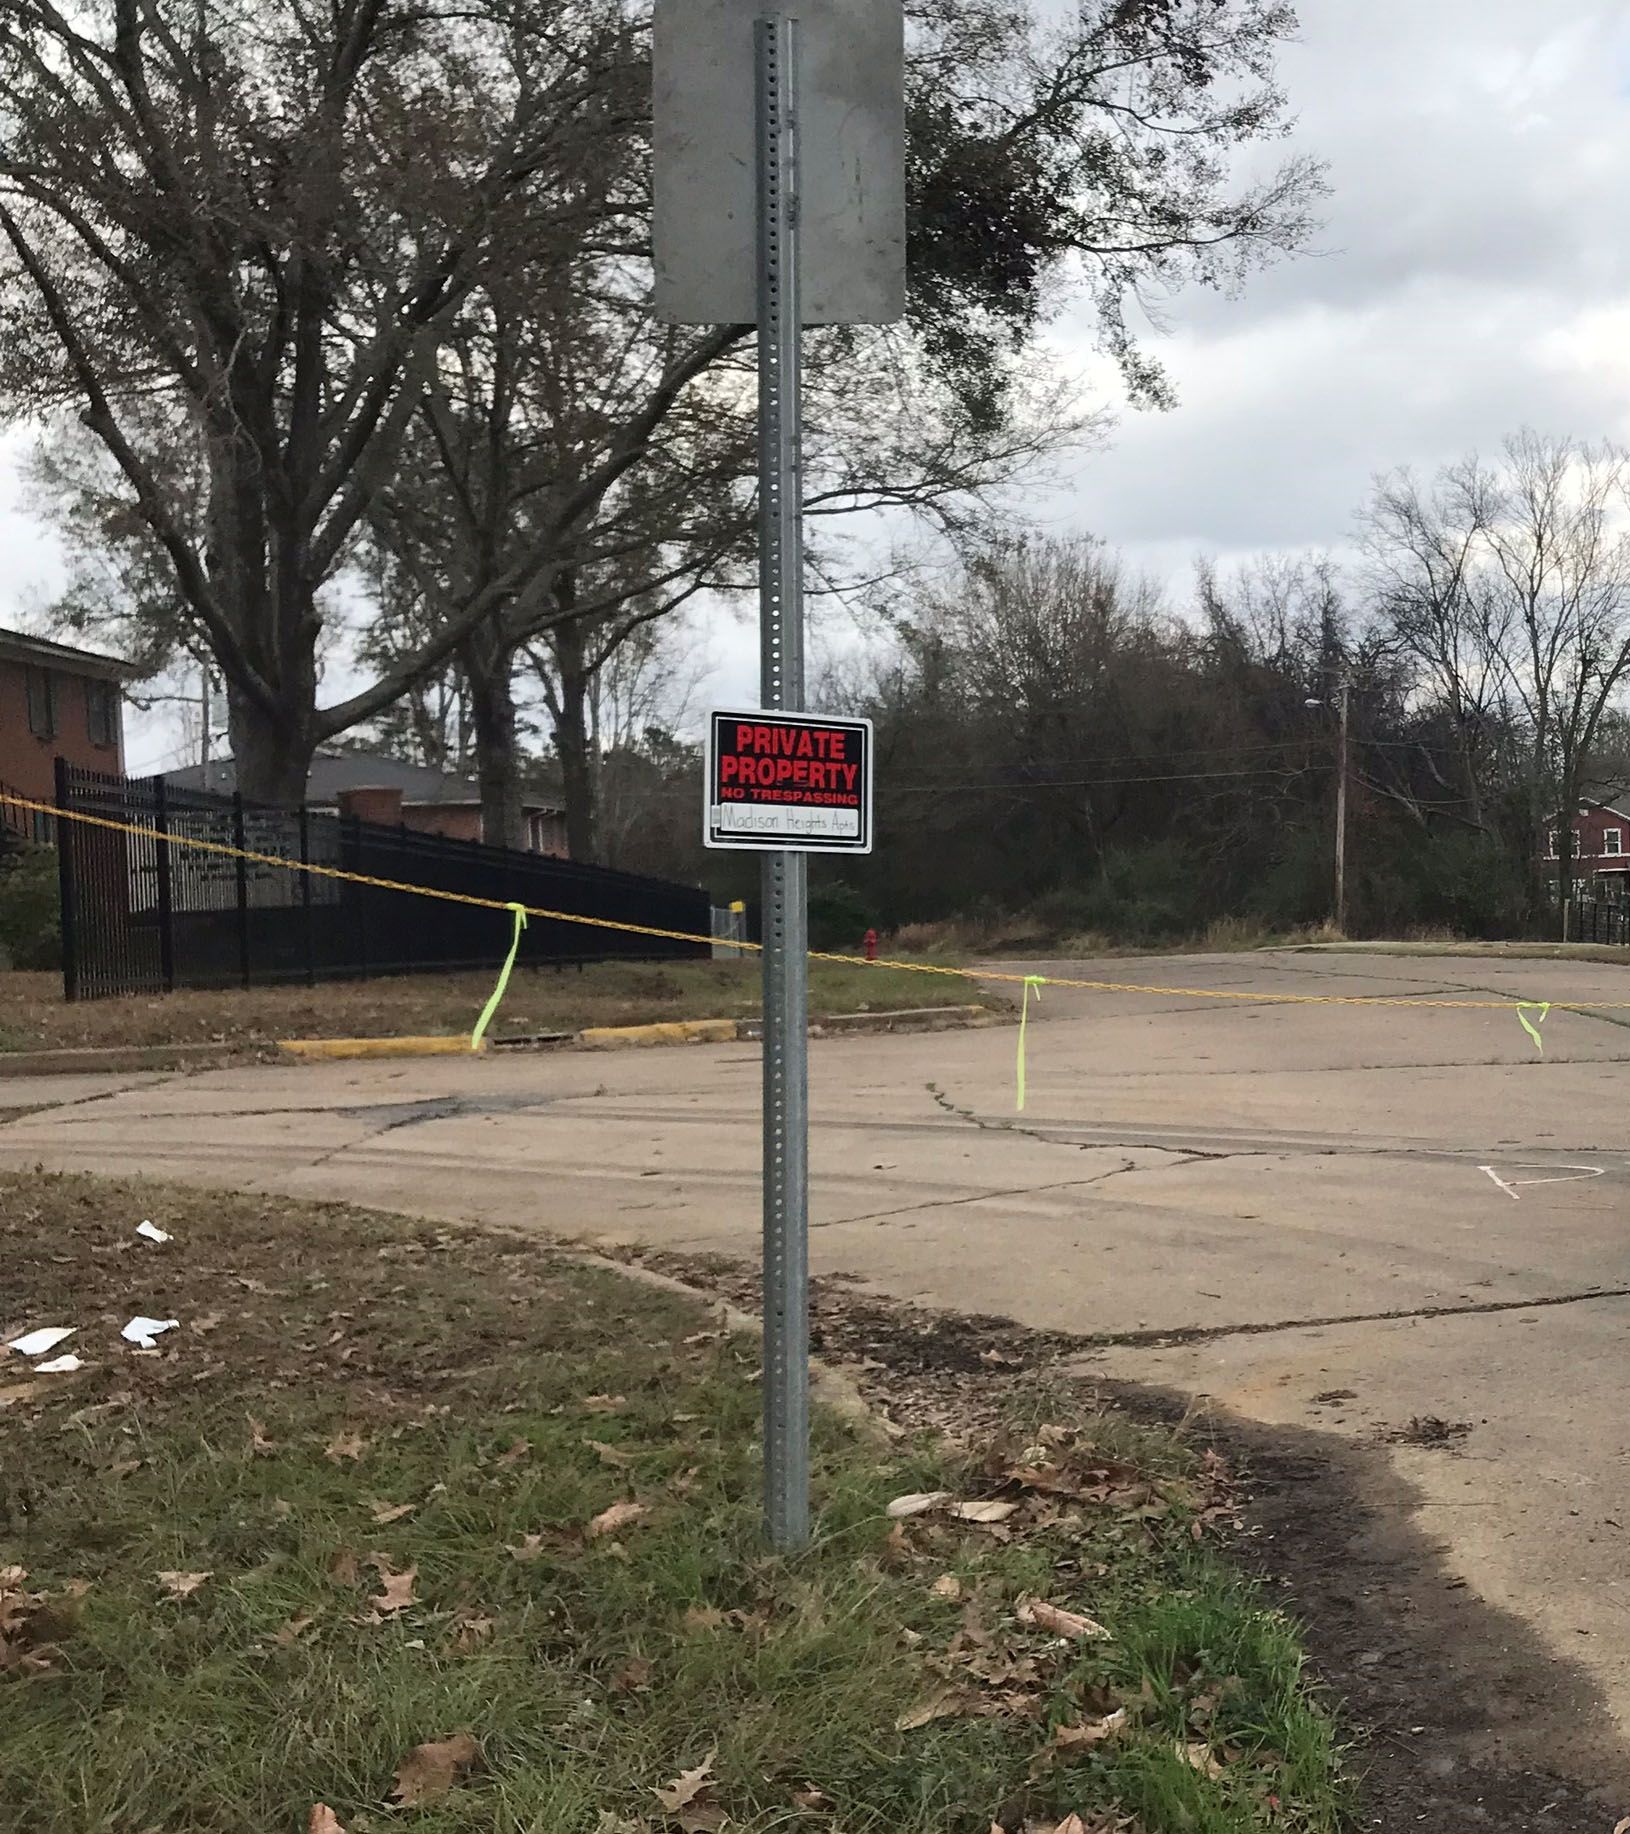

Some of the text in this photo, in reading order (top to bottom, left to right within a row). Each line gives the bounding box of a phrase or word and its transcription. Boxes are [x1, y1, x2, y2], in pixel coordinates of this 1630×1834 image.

[736, 725, 845, 759] PRIVATE
[721, 755, 858, 790] PROPERTY
[721, 787, 858, 805] NO TRESPASSING
[723, 804, 856, 835] Madison Heights Apts
